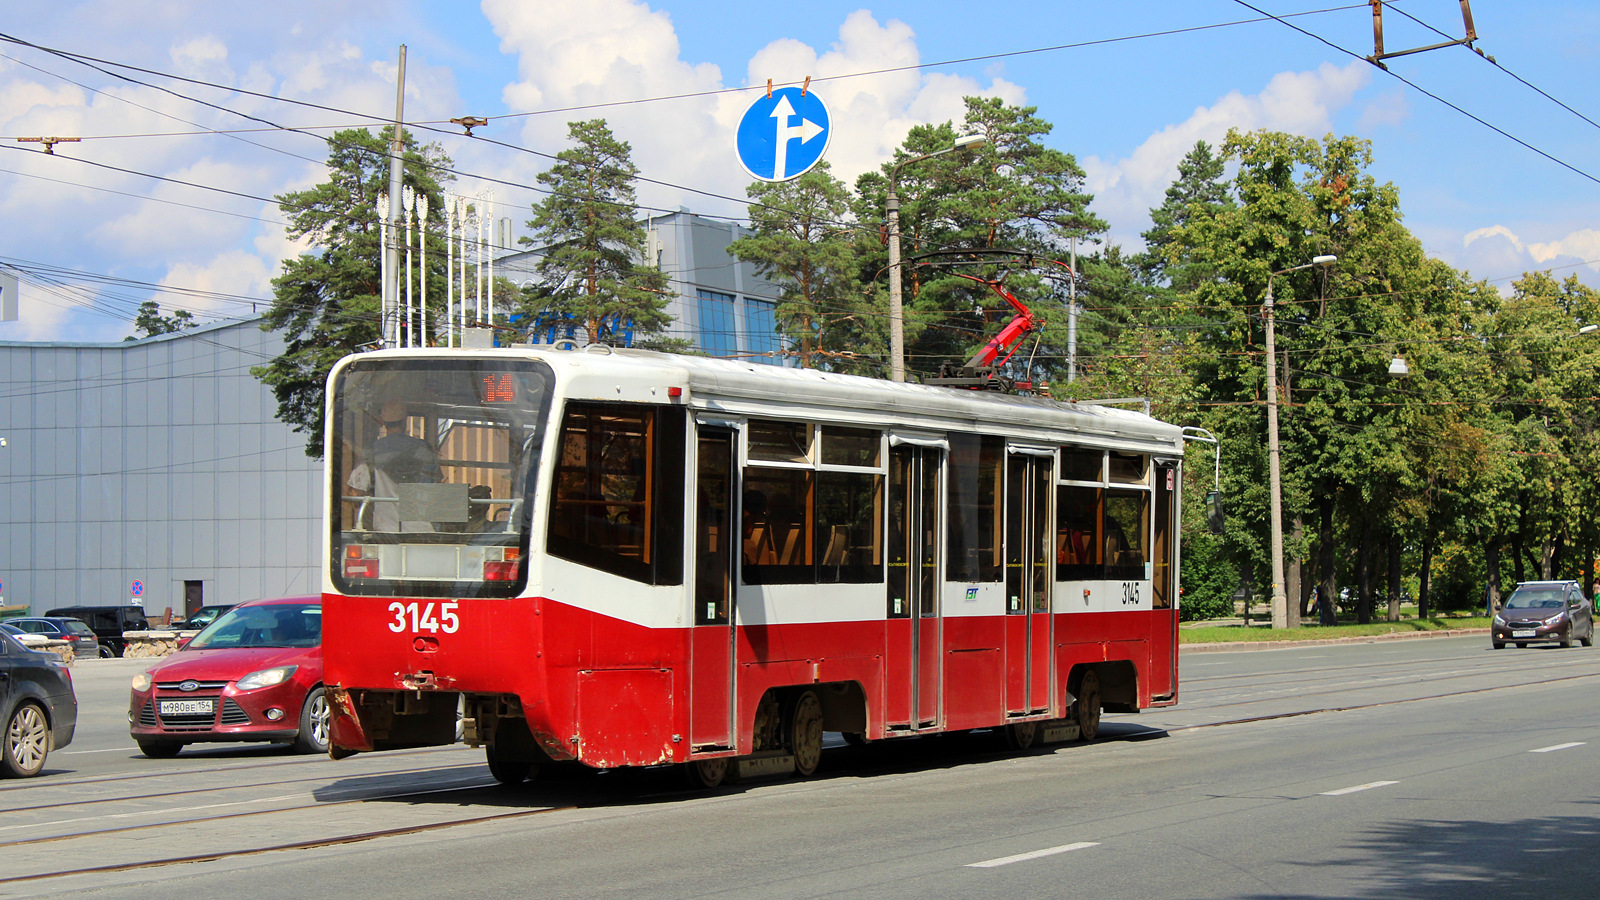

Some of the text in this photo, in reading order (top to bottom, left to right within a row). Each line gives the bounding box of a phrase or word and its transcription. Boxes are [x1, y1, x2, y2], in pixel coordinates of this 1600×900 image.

[483, 373, 514, 402] 14
[1122, 582, 1139, 604] 3145
[388, 602, 460, 634] 3145
